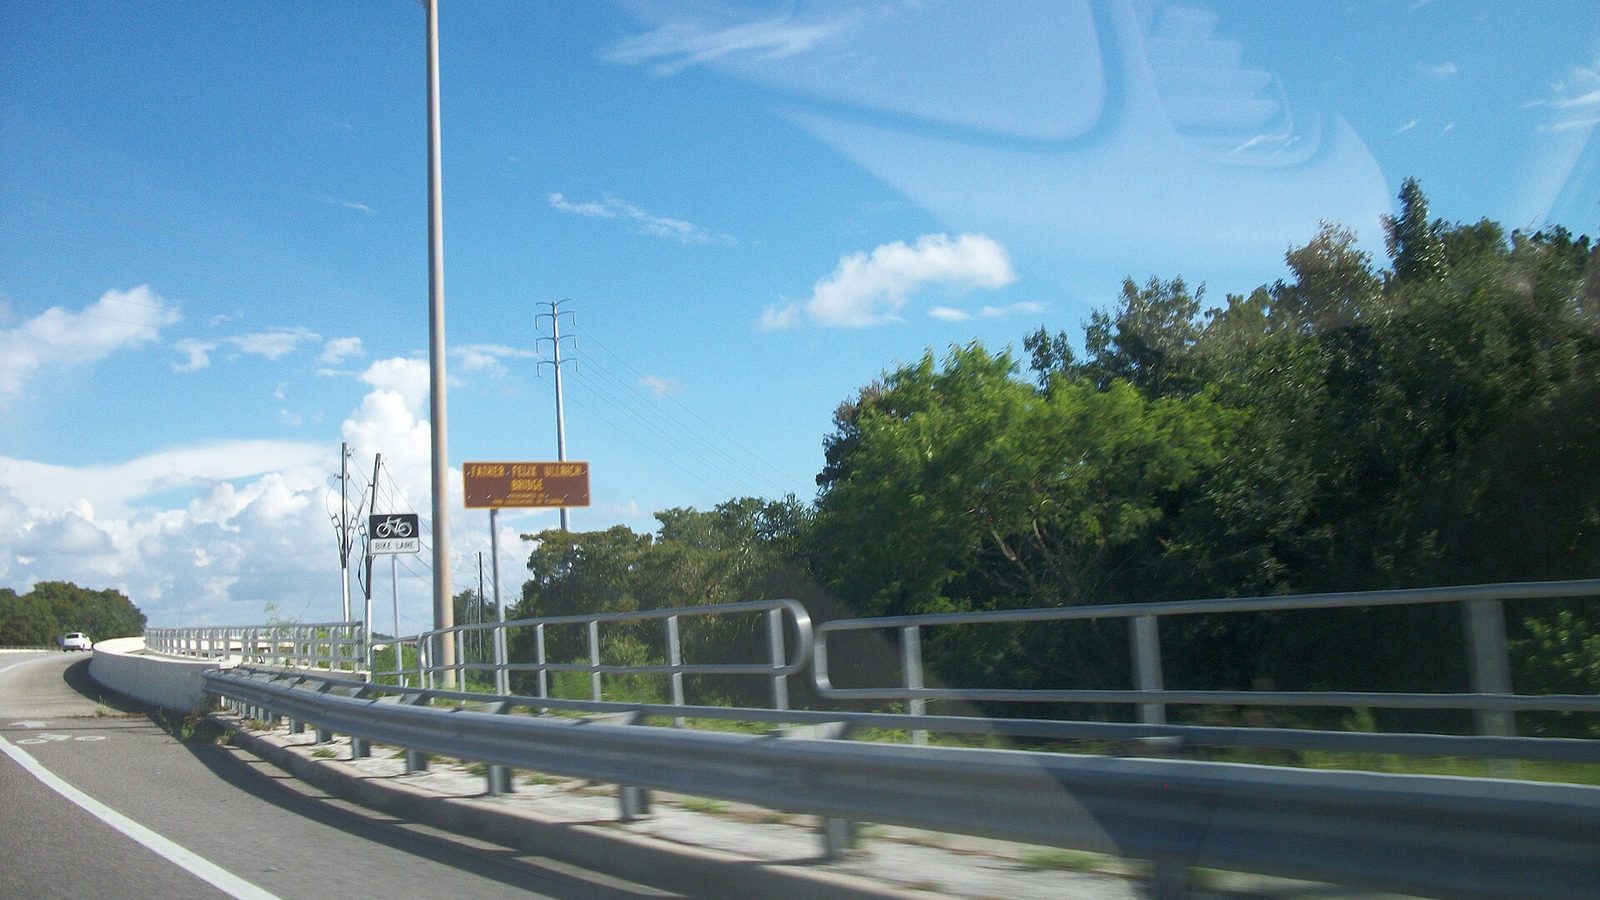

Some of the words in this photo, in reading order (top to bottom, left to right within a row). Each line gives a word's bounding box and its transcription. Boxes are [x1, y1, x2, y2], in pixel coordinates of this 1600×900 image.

[471, 465, 505, 477] FATHER
[511, 465, 537, 477] FELIX
[511, 479, 544, 491] BRIDGE
[375, 541, 392, 550] BIKE
[396, 540, 415, 549] LANE
